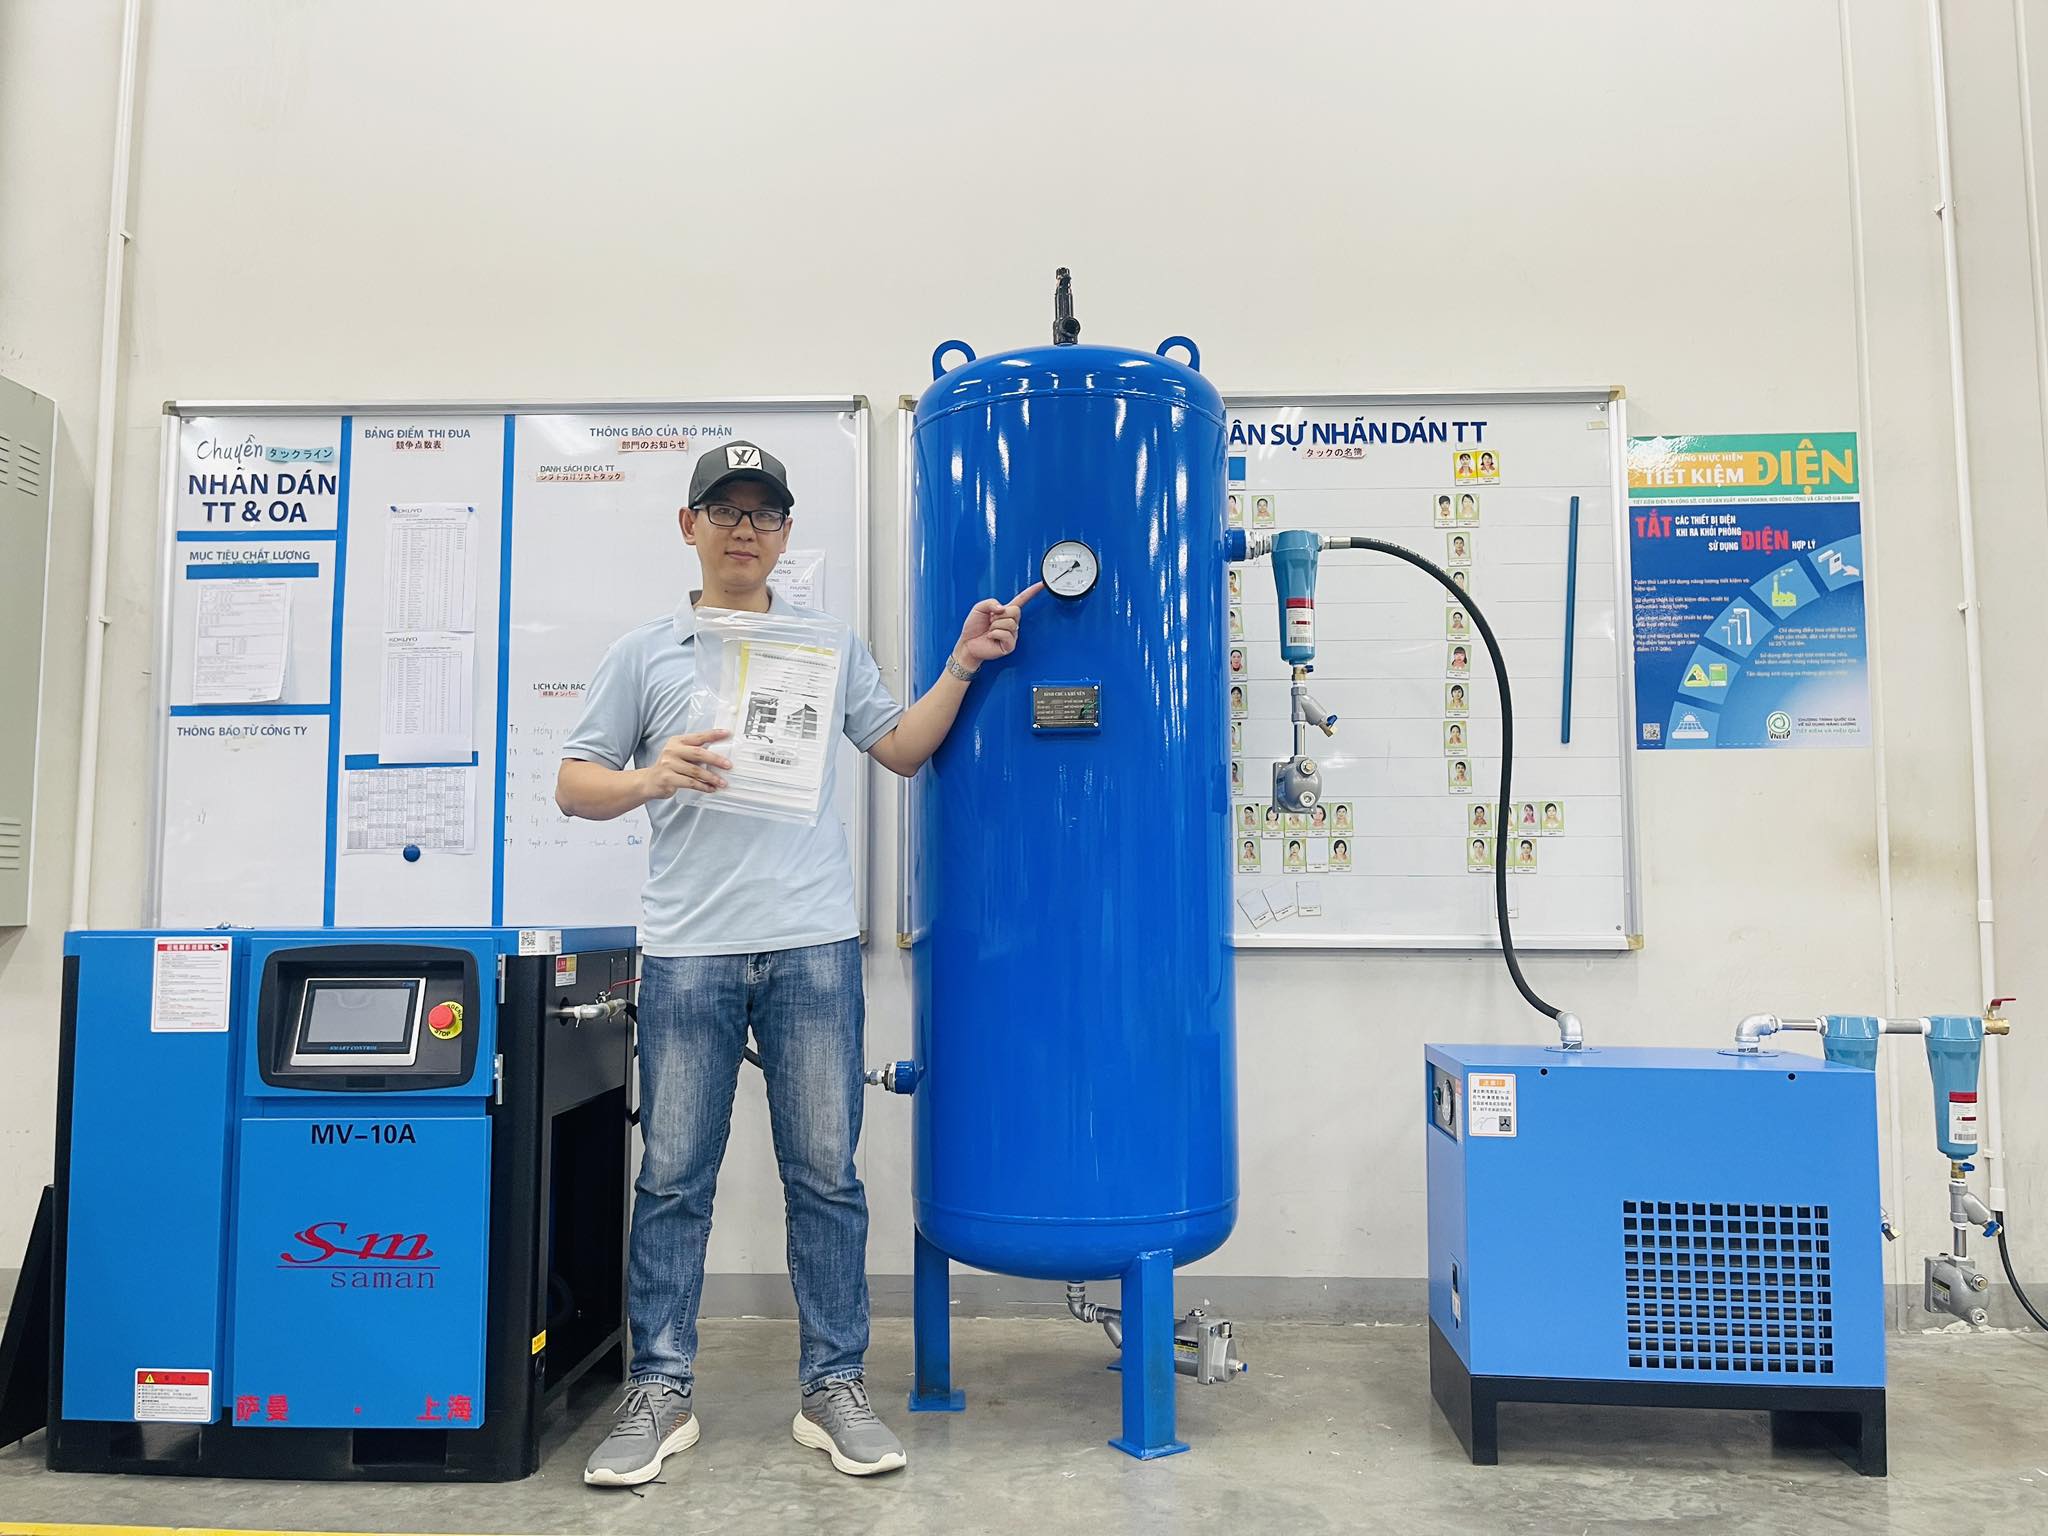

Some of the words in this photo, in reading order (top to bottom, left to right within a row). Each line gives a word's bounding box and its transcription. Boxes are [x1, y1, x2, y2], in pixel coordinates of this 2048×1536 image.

[365, 426, 394, 438] BẢNG
[397, 425, 424, 439] ĐIỂM
[428, 429, 446, 439] THI
[448, 429, 471, 439] ĐUA
[590, 425, 628, 437] THÔNG
[632, 424, 653, 437] BÁO
[656, 424, 679, 437] CỦA
[682, 424, 698, 439] BỘ
[702, 424, 732, 439] PHẬN
[1228, 419, 1267, 446] ÂN
[1271, 421, 1308, 451] SỰ
[1312, 416, 1387, 446] NHÃN
[1391, 415, 1447, 445] DÁN
[1452, 421, 1487, 443] TT
[621, 440, 685, 450] 部門のお知らせ
[270, 448, 333, 459] タックライン
[540, 465, 562, 473] DANH
[563, 463, 583, 473] SÁCH
[605, 464, 615, 472] TT
[1756, 438, 1855, 495] ĐIỆN
[188, 466, 269, 495] NHÃN
[277, 469, 337, 495] DÁN
[1691, 463, 1745, 487] KIỆM
[202, 502, 236, 523] TT
[241, 500, 262, 522] &
[268, 500, 308, 523] OA
[1675, 514, 1689, 525] CÁC
[1691, 513, 1708, 525] THIẾT
[1635, 509, 1672, 538] TẮT
[1676, 527, 1688, 537] KHI
[1690, 527, 1699, 537] RA
[1741, 525, 1789, 555] ĐIỆN
[1791, 540, 1806, 551] HỢP
[190, 551, 213, 563] MỤC
[217, 549, 239, 560] TIÊU
[242, 548, 270, 560] CHẤT
[273, 550, 311, 563] LƯỢNG
[177, 725, 215, 737] THÔNG
[218, 725, 240, 736] BÁO
[243, 724, 259, 736] TỪ
[260, 724, 291, 736] CÔNG
[294, 726, 308, 736] TY
[434, 1029, 451, 1037] STOP
[311, 1124, 416, 1145] MV-10A
[331, 1271, 434, 1289] saman
[236, 1395, 289, 1422] 萨曼
[416, 1395, 472, 1422] 上海
